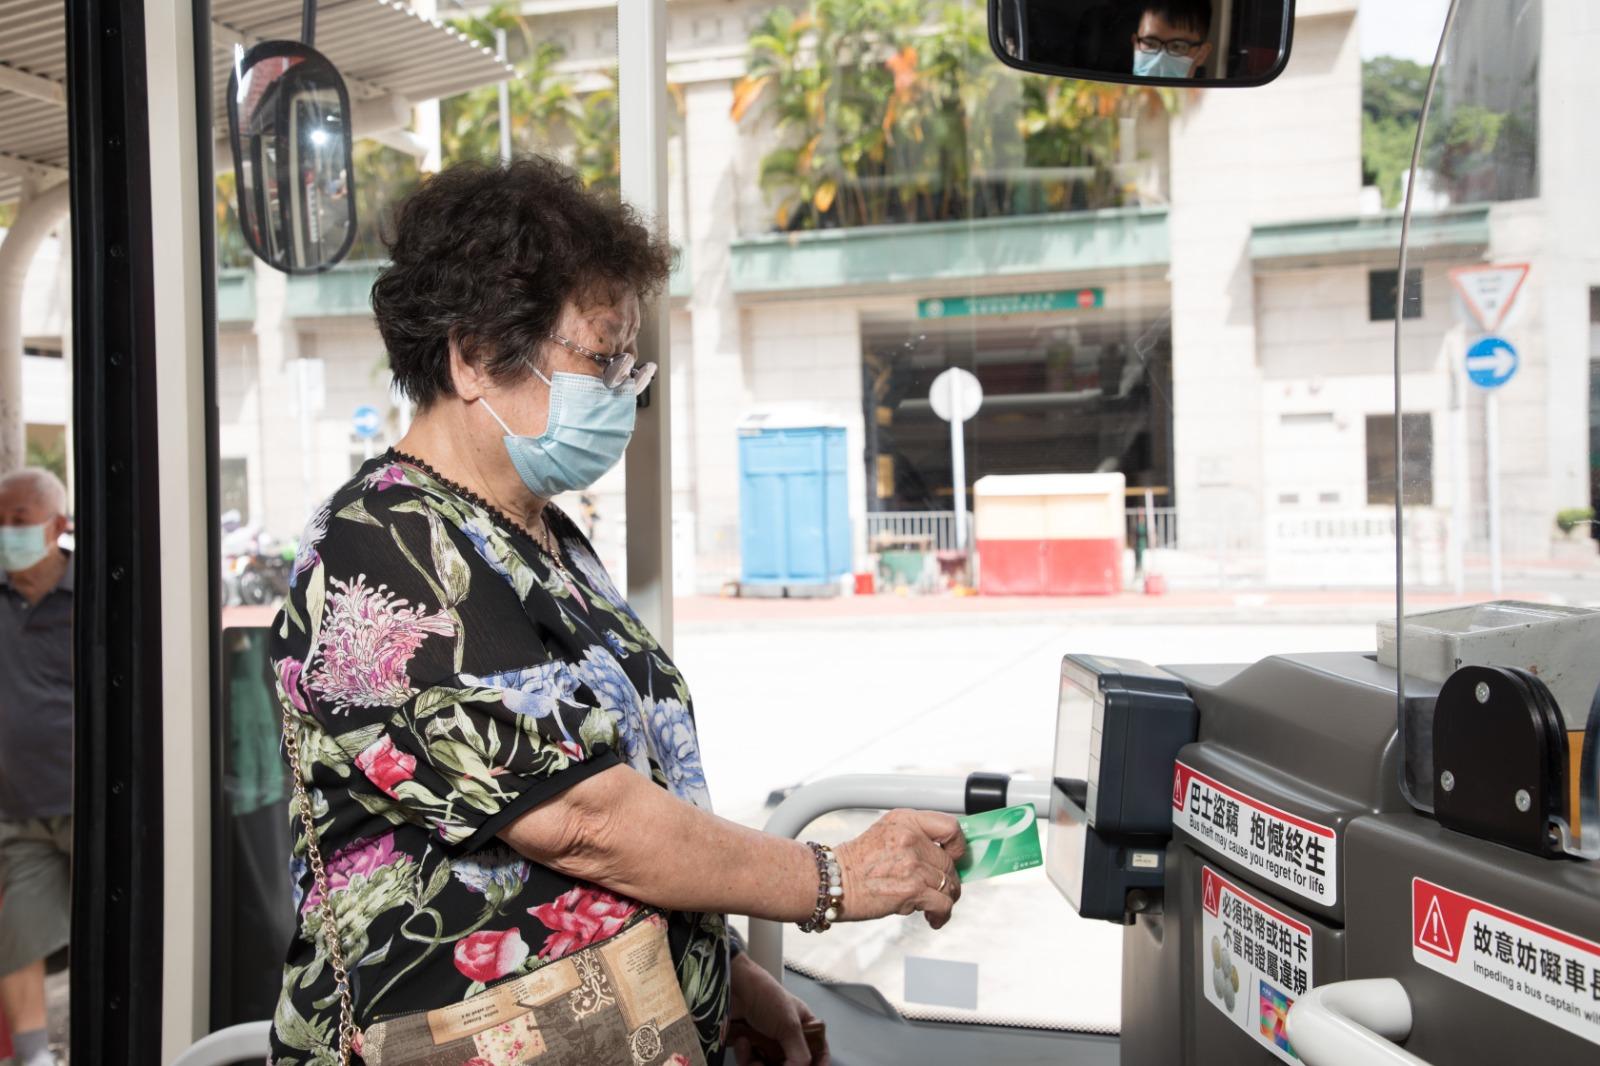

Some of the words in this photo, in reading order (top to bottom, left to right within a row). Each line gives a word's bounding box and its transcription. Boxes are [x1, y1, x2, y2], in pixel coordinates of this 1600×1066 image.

[1189, 814, 1200, 832] Bus
[1200, 822, 1214, 840] theft
[1214, 832, 1228, 851] may
[1228, 839, 1249, 859] cause
[1249, 850, 1264, 868] you
[1265, 859, 1291, 881] regret
[1293, 868, 1307, 887] for
[1308, 875, 1325, 895] life
[1190, 782, 1240, 837] 巴士盜竊
[1250, 811, 1325, 877] 抱憾終生
[1222, 891, 1307, 963] 必須投幣或拍卡
[1222, 921, 1307, 996] 不當用證屬違規
[1473, 960, 1514, 991] Impeding
[1516, 981, 1522, 992] a
[1524, 982, 1542, 1000] bus
[1544, 993, 1582, 1018] captain
